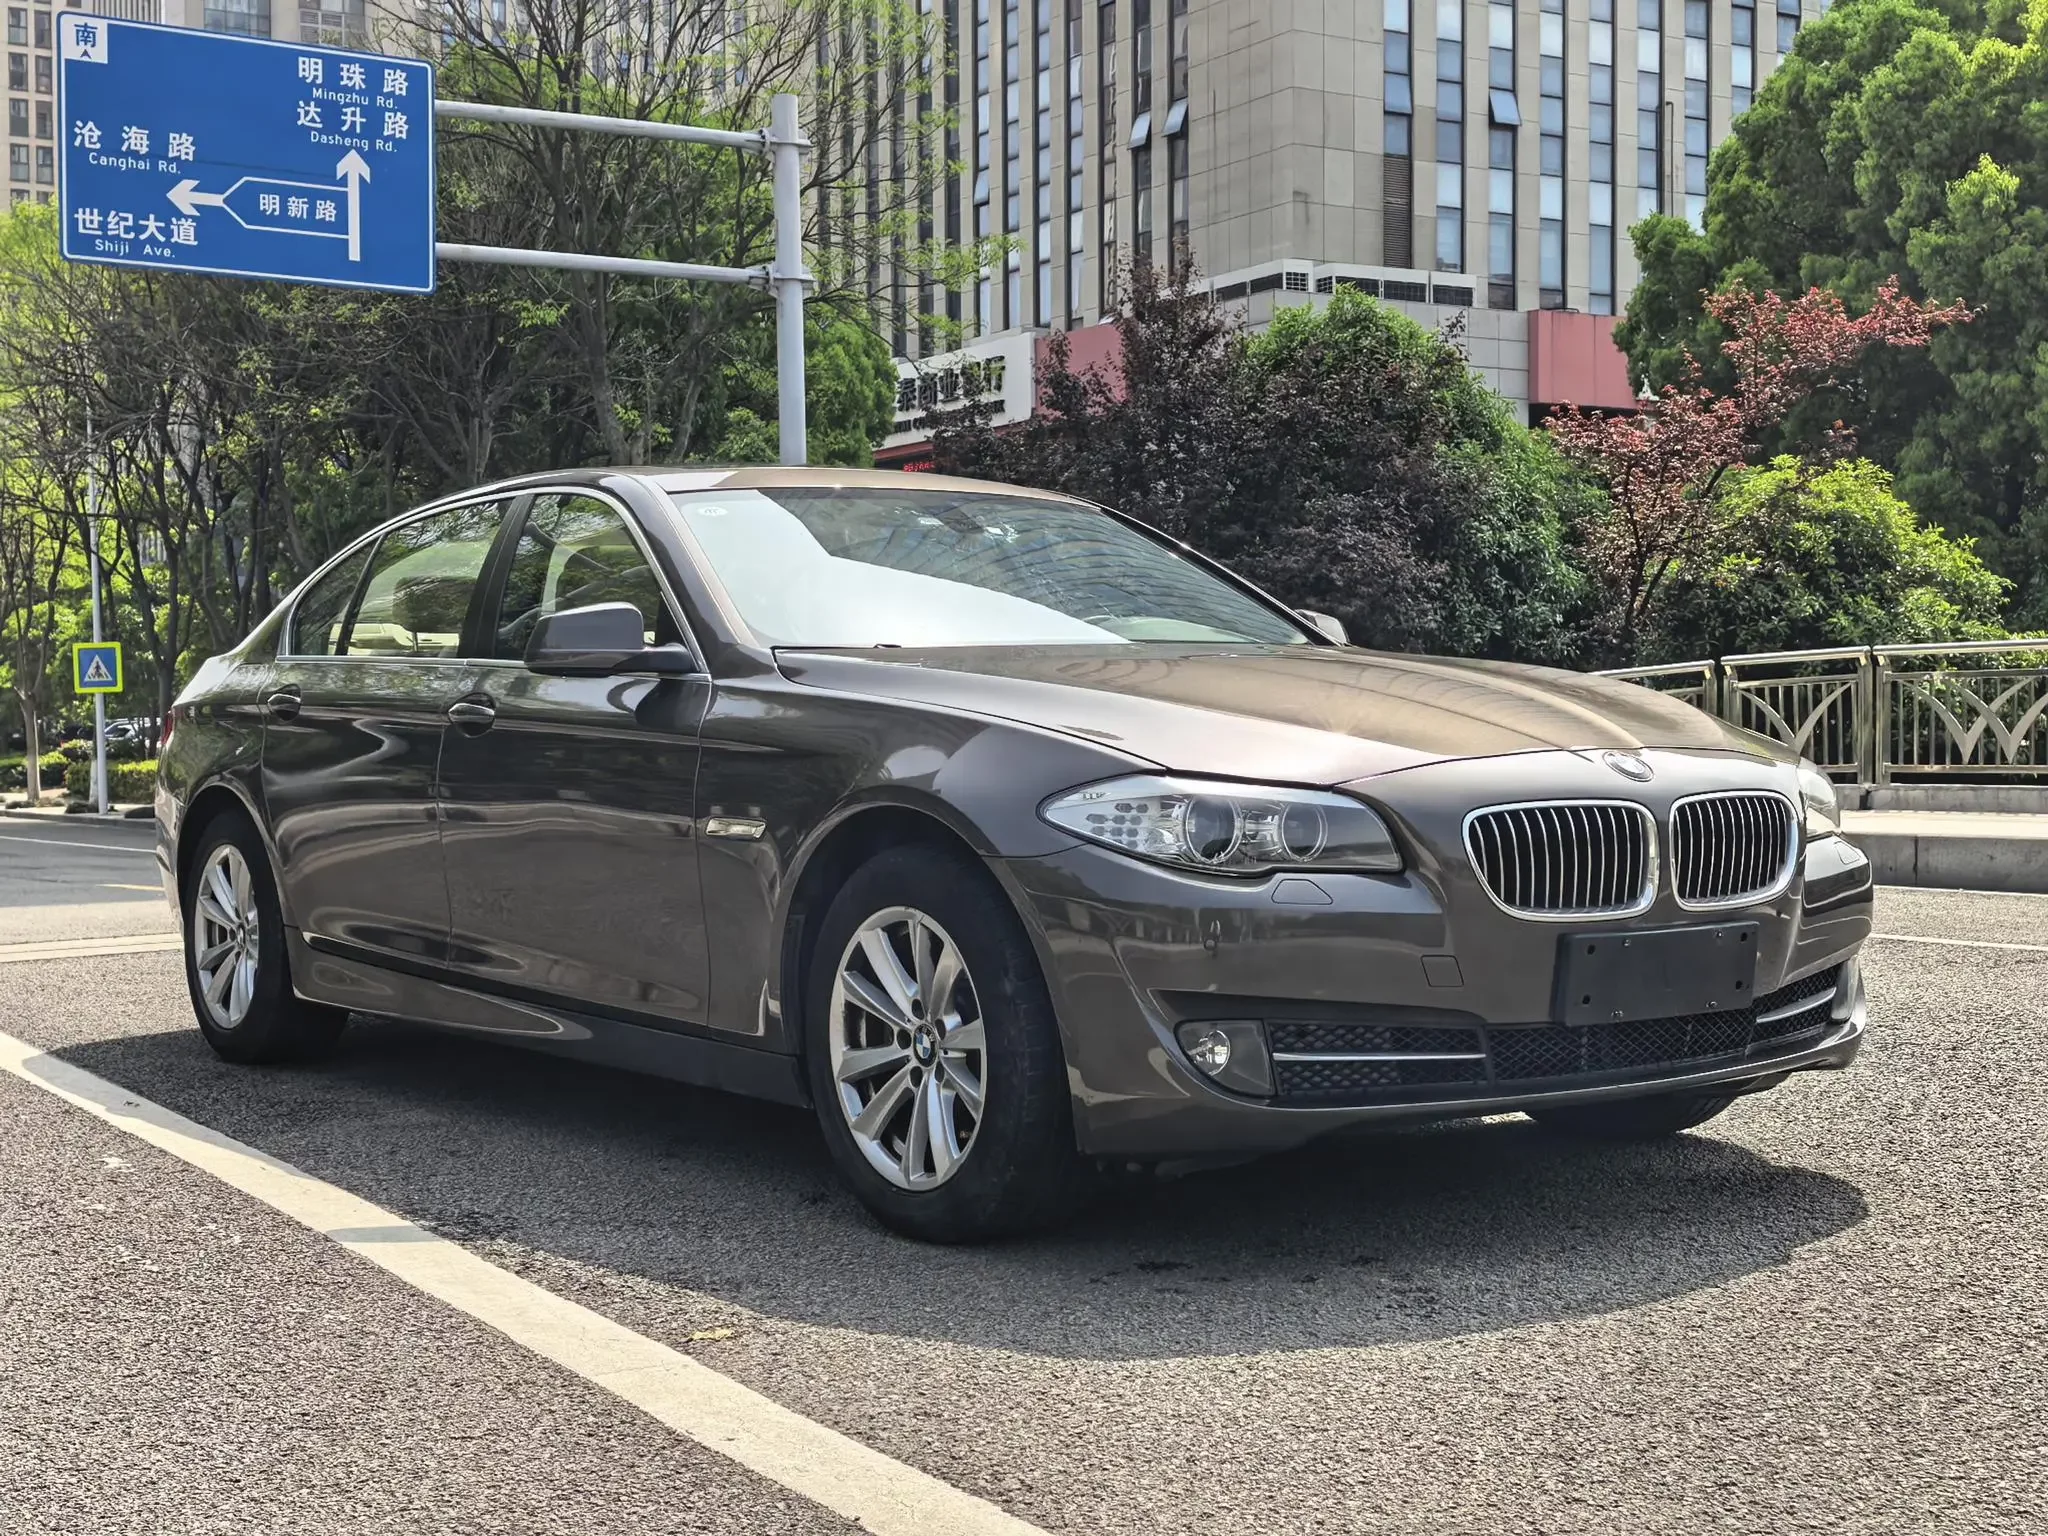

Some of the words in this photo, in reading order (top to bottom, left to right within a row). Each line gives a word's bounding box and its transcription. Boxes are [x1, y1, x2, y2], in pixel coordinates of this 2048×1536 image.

[74, 22, 98, 48] 南
[298, 56, 409, 96] 明珠路
[312, 87, 369, 105] Mingzhu
[376, 95, 398, 109] Rd.
[296, 100, 409, 140] 达升路
[73, 120, 196, 161] 沧海路
[310, 130, 369, 152] Dasheng
[375, 139, 398, 153] Rd.
[88, 152, 150, 171] Canghai
[158, 160, 181, 174] Rd.
[259, 193, 337, 222] 明新路
[74, 207, 199, 246] 世纪大道
[94, 238, 129, 256] Shiji
[143, 244, 176, 259] Ave.
